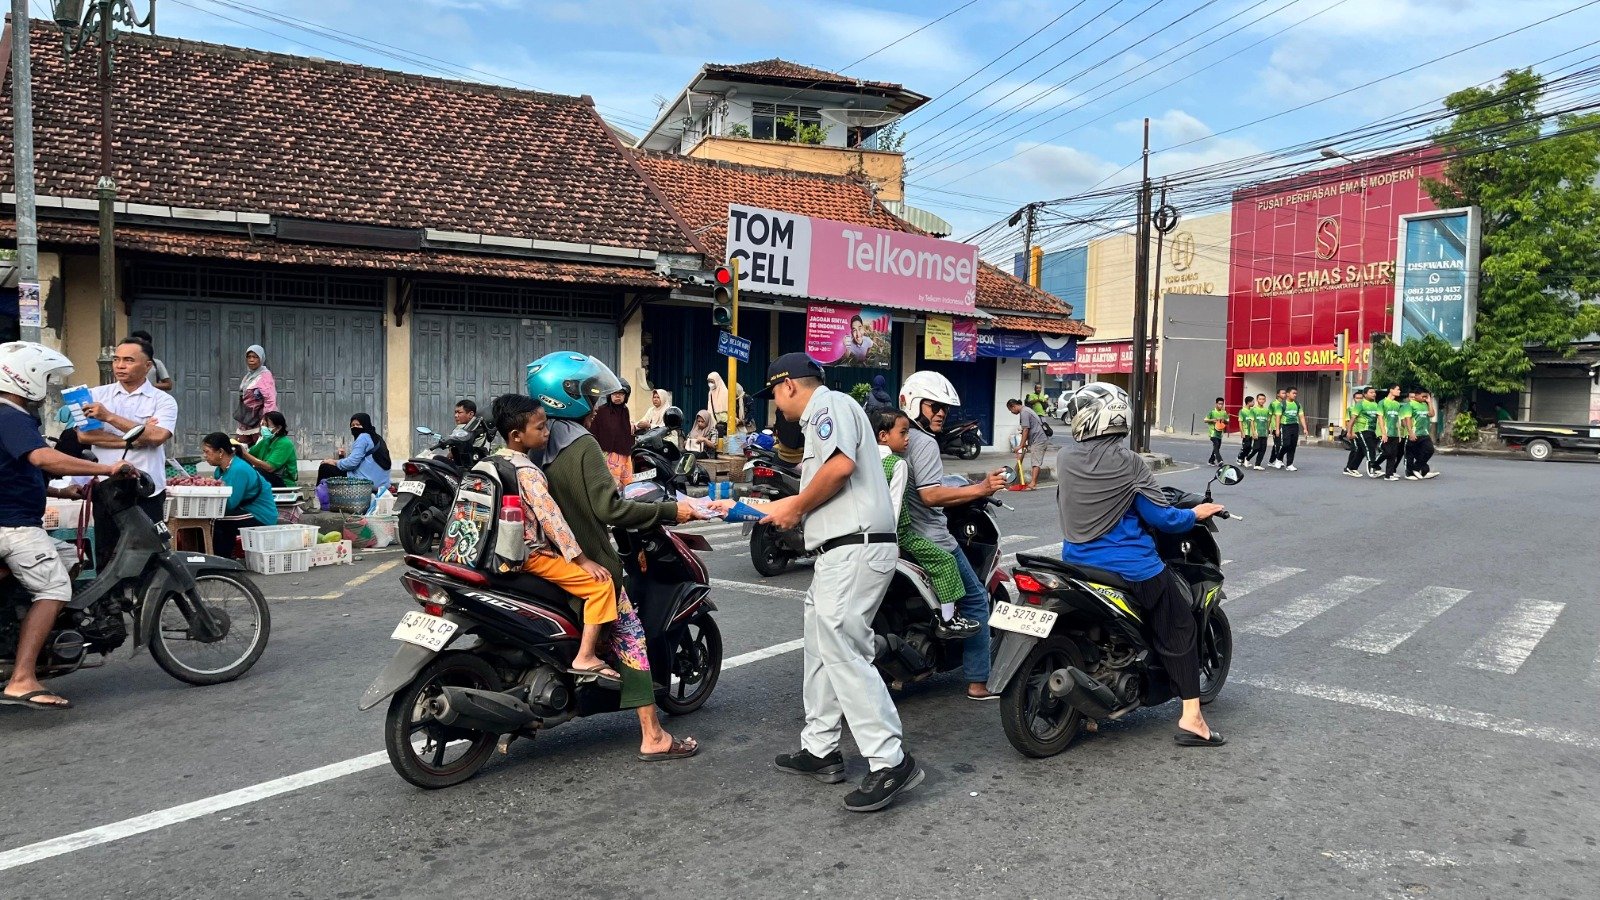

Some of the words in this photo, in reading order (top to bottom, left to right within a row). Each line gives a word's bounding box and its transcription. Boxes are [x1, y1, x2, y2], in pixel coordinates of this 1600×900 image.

[1258, 197, 1284, 211] PUSAT
[1287, 185, 1336, 206] PERHIASAN
[1339, 177, 1367, 195] EMAS
[1369, 168, 1415, 188] MODERN
[730, 209, 795, 250] TOM
[730, 248, 795, 287] CELL
[842, 229, 979, 286] Telkomsel
[1407, 260, 1464, 271] DISEWAKAN
[1254, 273, 1293, 294] TOKO
[1298, 267, 1341, 289] EMAS
[1236, 353, 1267, 368] BUKA
[1268, 351, 1301, 367] 08.00
[996, 604, 1010, 616] AB
[1012, 608, 1037, 621] 5279
[1039, 612, 1054, 624] BP
[437, 623, 453, 636] CP
